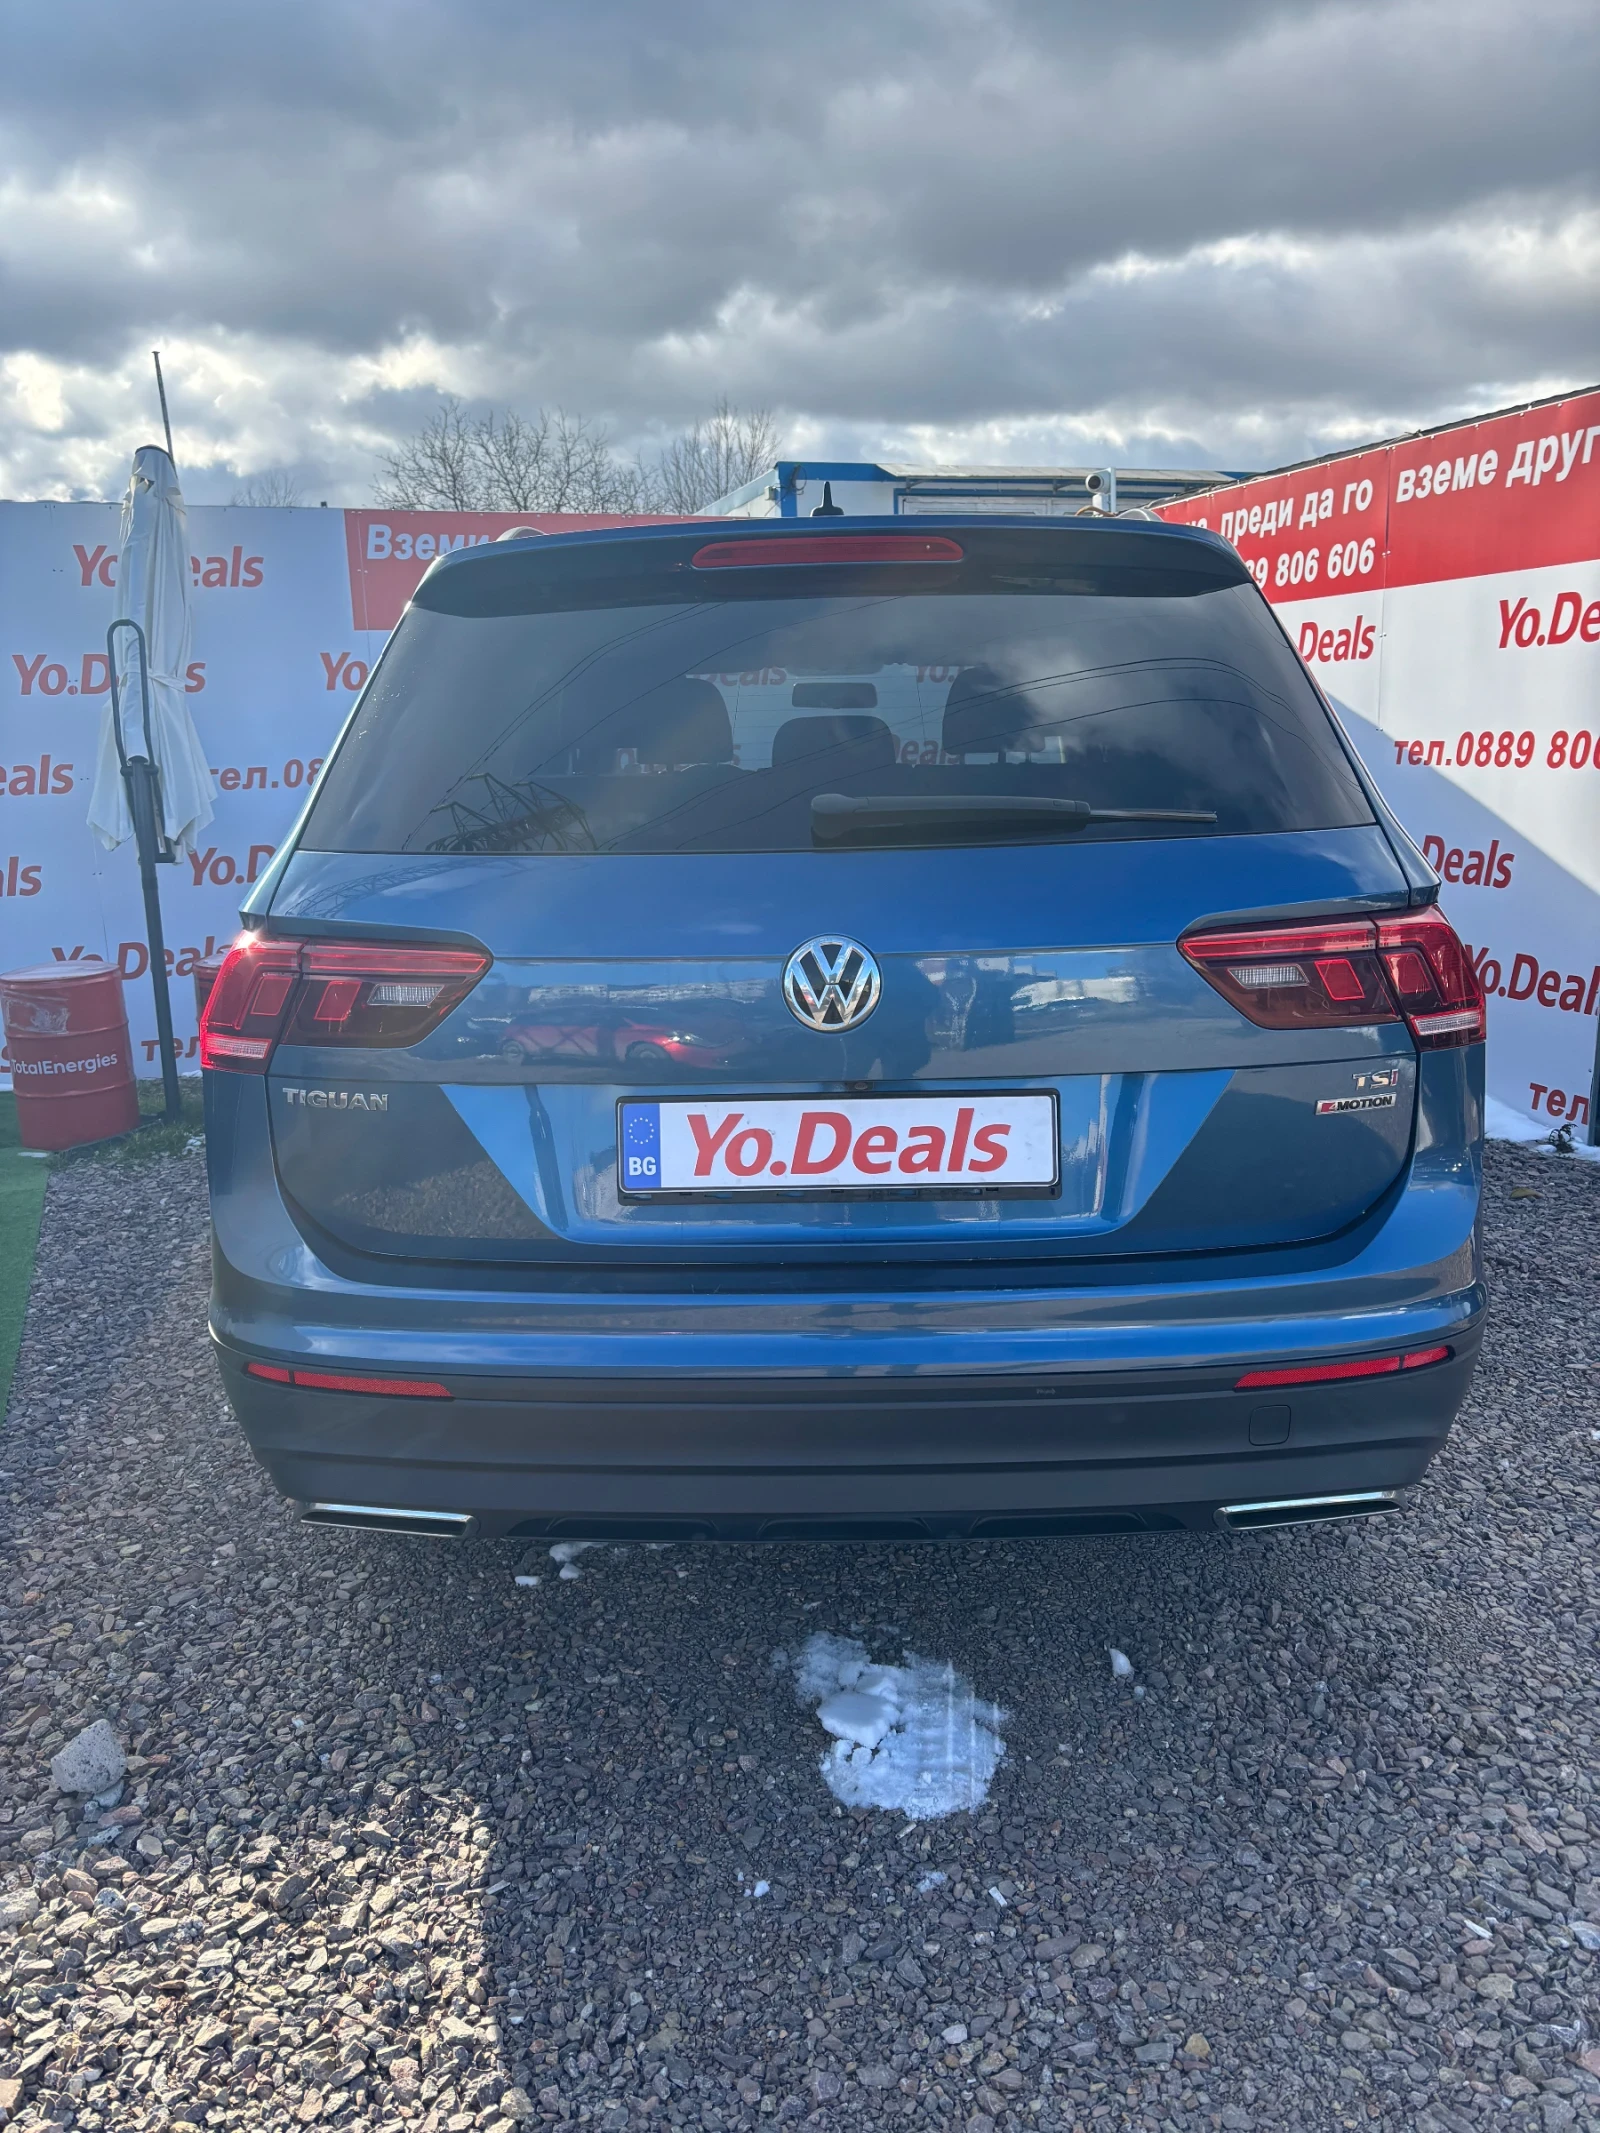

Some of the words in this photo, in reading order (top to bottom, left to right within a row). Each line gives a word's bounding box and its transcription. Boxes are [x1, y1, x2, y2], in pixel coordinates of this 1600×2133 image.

[1221, 498, 1295, 547] преди
[1298, 487, 1334, 531] да
[1342, 478, 1374, 515] го
[1395, 449, 1499, 503] вземе
[1275, 547, 1320, 588] 806
[1327, 537, 1376, 580] 606
[1394, 730, 1536, 769] тел.0889
[11, 1053, 118, 1075] TotalEnergies
[1352, 1068, 1399, 1091] TSI
[282, 1087, 389, 1112] TIGUAN
[686, 1107, 1012, 1177] Yo.Deals
[628, 1156, 657, 1176] BG
